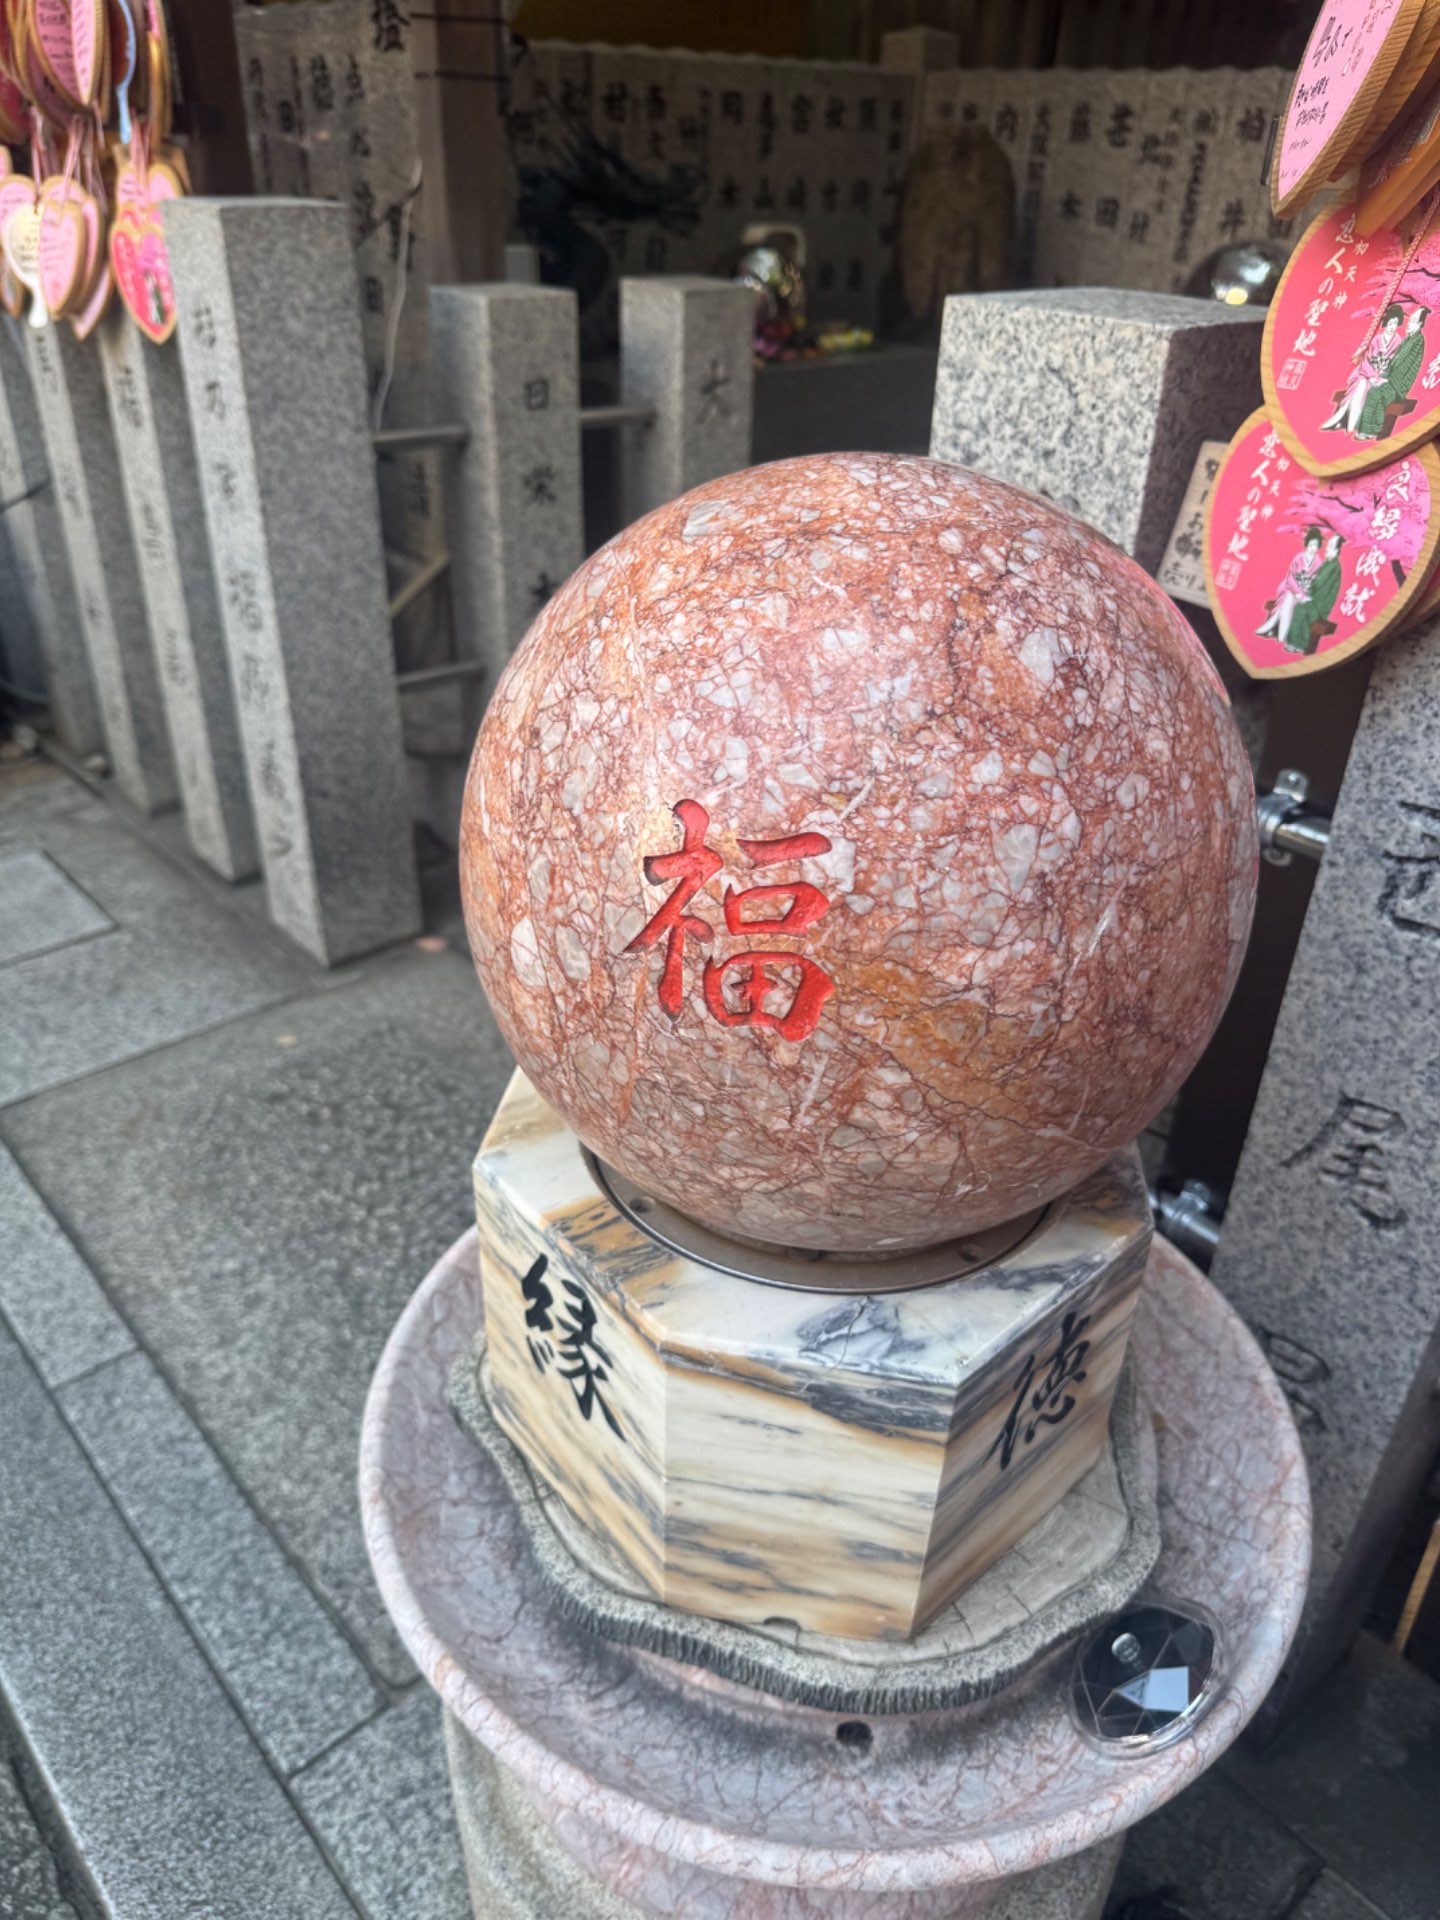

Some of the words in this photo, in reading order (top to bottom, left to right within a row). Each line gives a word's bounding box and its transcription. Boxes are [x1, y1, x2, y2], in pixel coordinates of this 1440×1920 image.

[1292, 213, 1357, 357] 恋人の聖地
[1227, 429, 1281, 562] 恋人の聖地
[1339, 460, 1411, 624] 良縁成就
[623, 798, 835, 1042] 福
[521, 1253, 625, 1441] 縁
